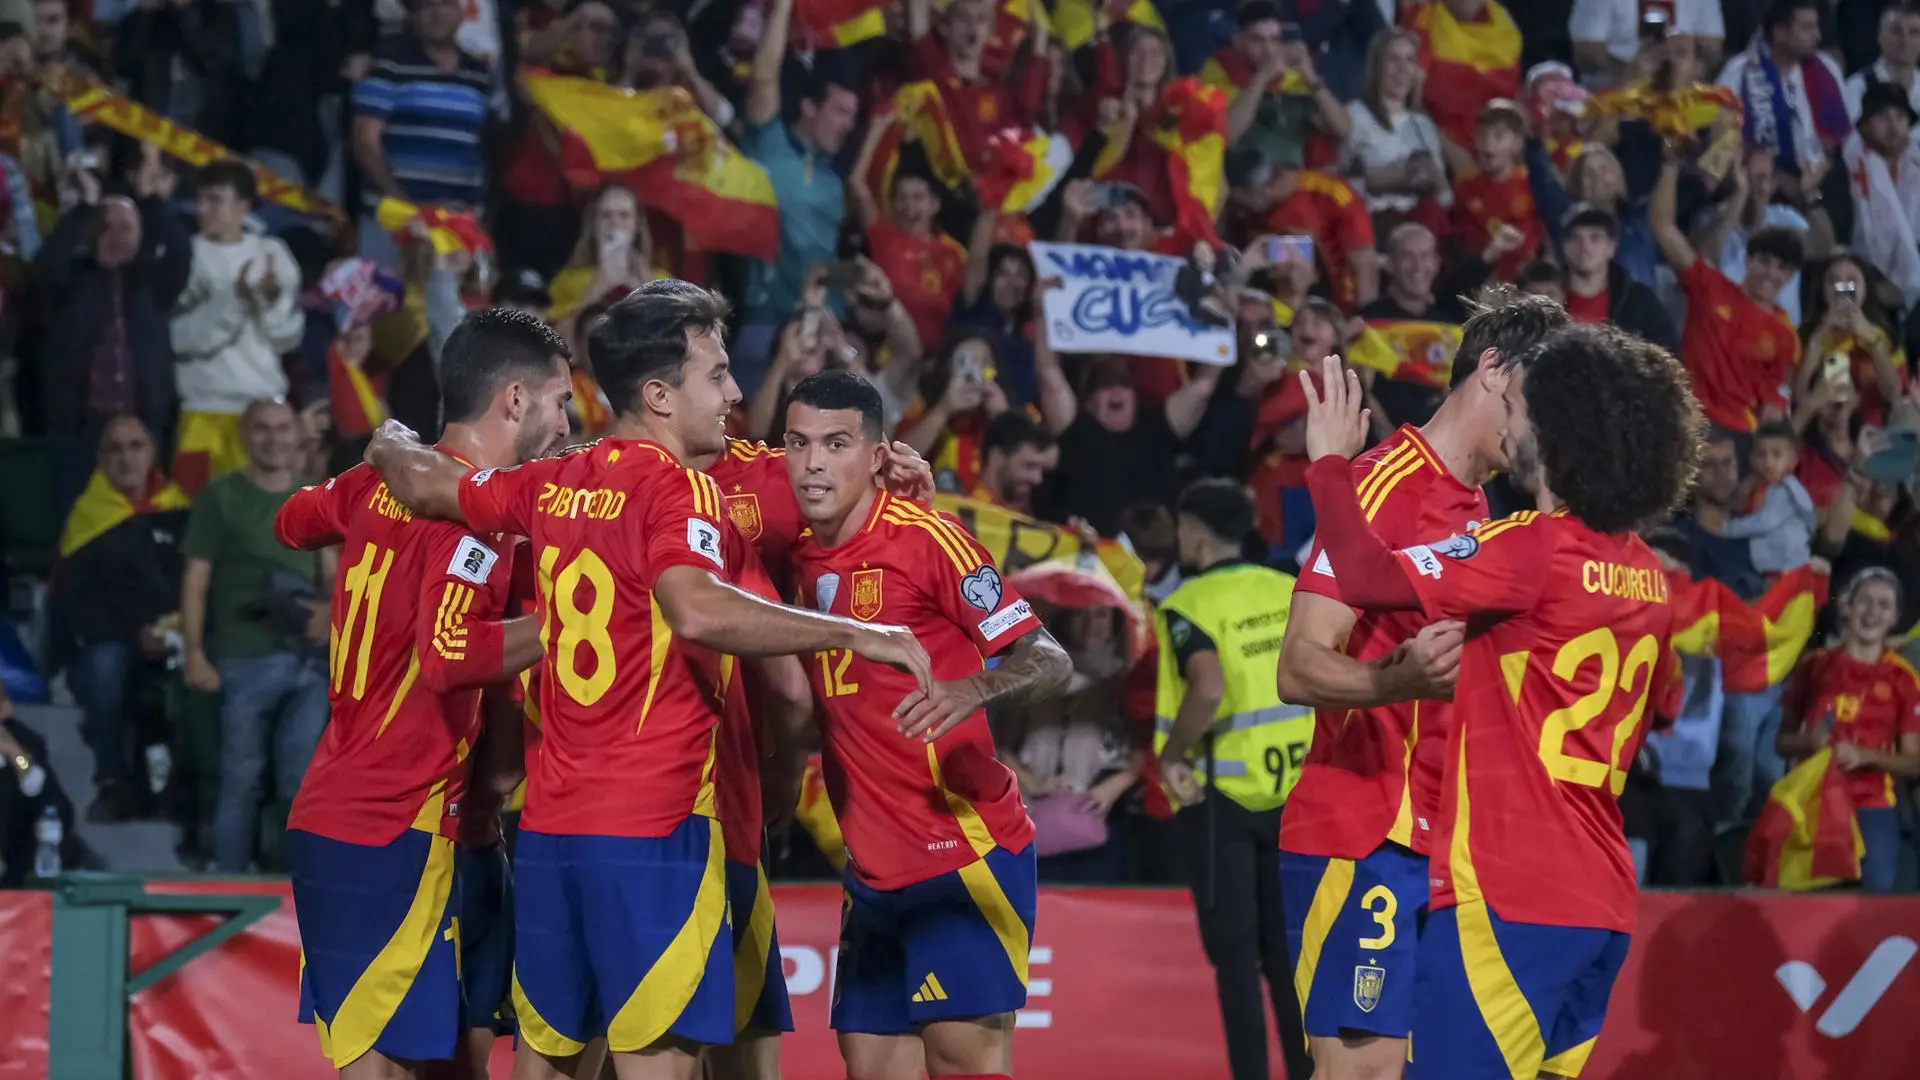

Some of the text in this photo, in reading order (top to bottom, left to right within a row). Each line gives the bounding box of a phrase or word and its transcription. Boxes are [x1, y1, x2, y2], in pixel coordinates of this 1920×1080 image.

[335, 541, 395, 701] 11
[538, 545, 617, 707] 18
[815, 648, 859, 698] 12
[1538, 627, 1659, 797] 22
[1359, 885, 1398, 950] 3
